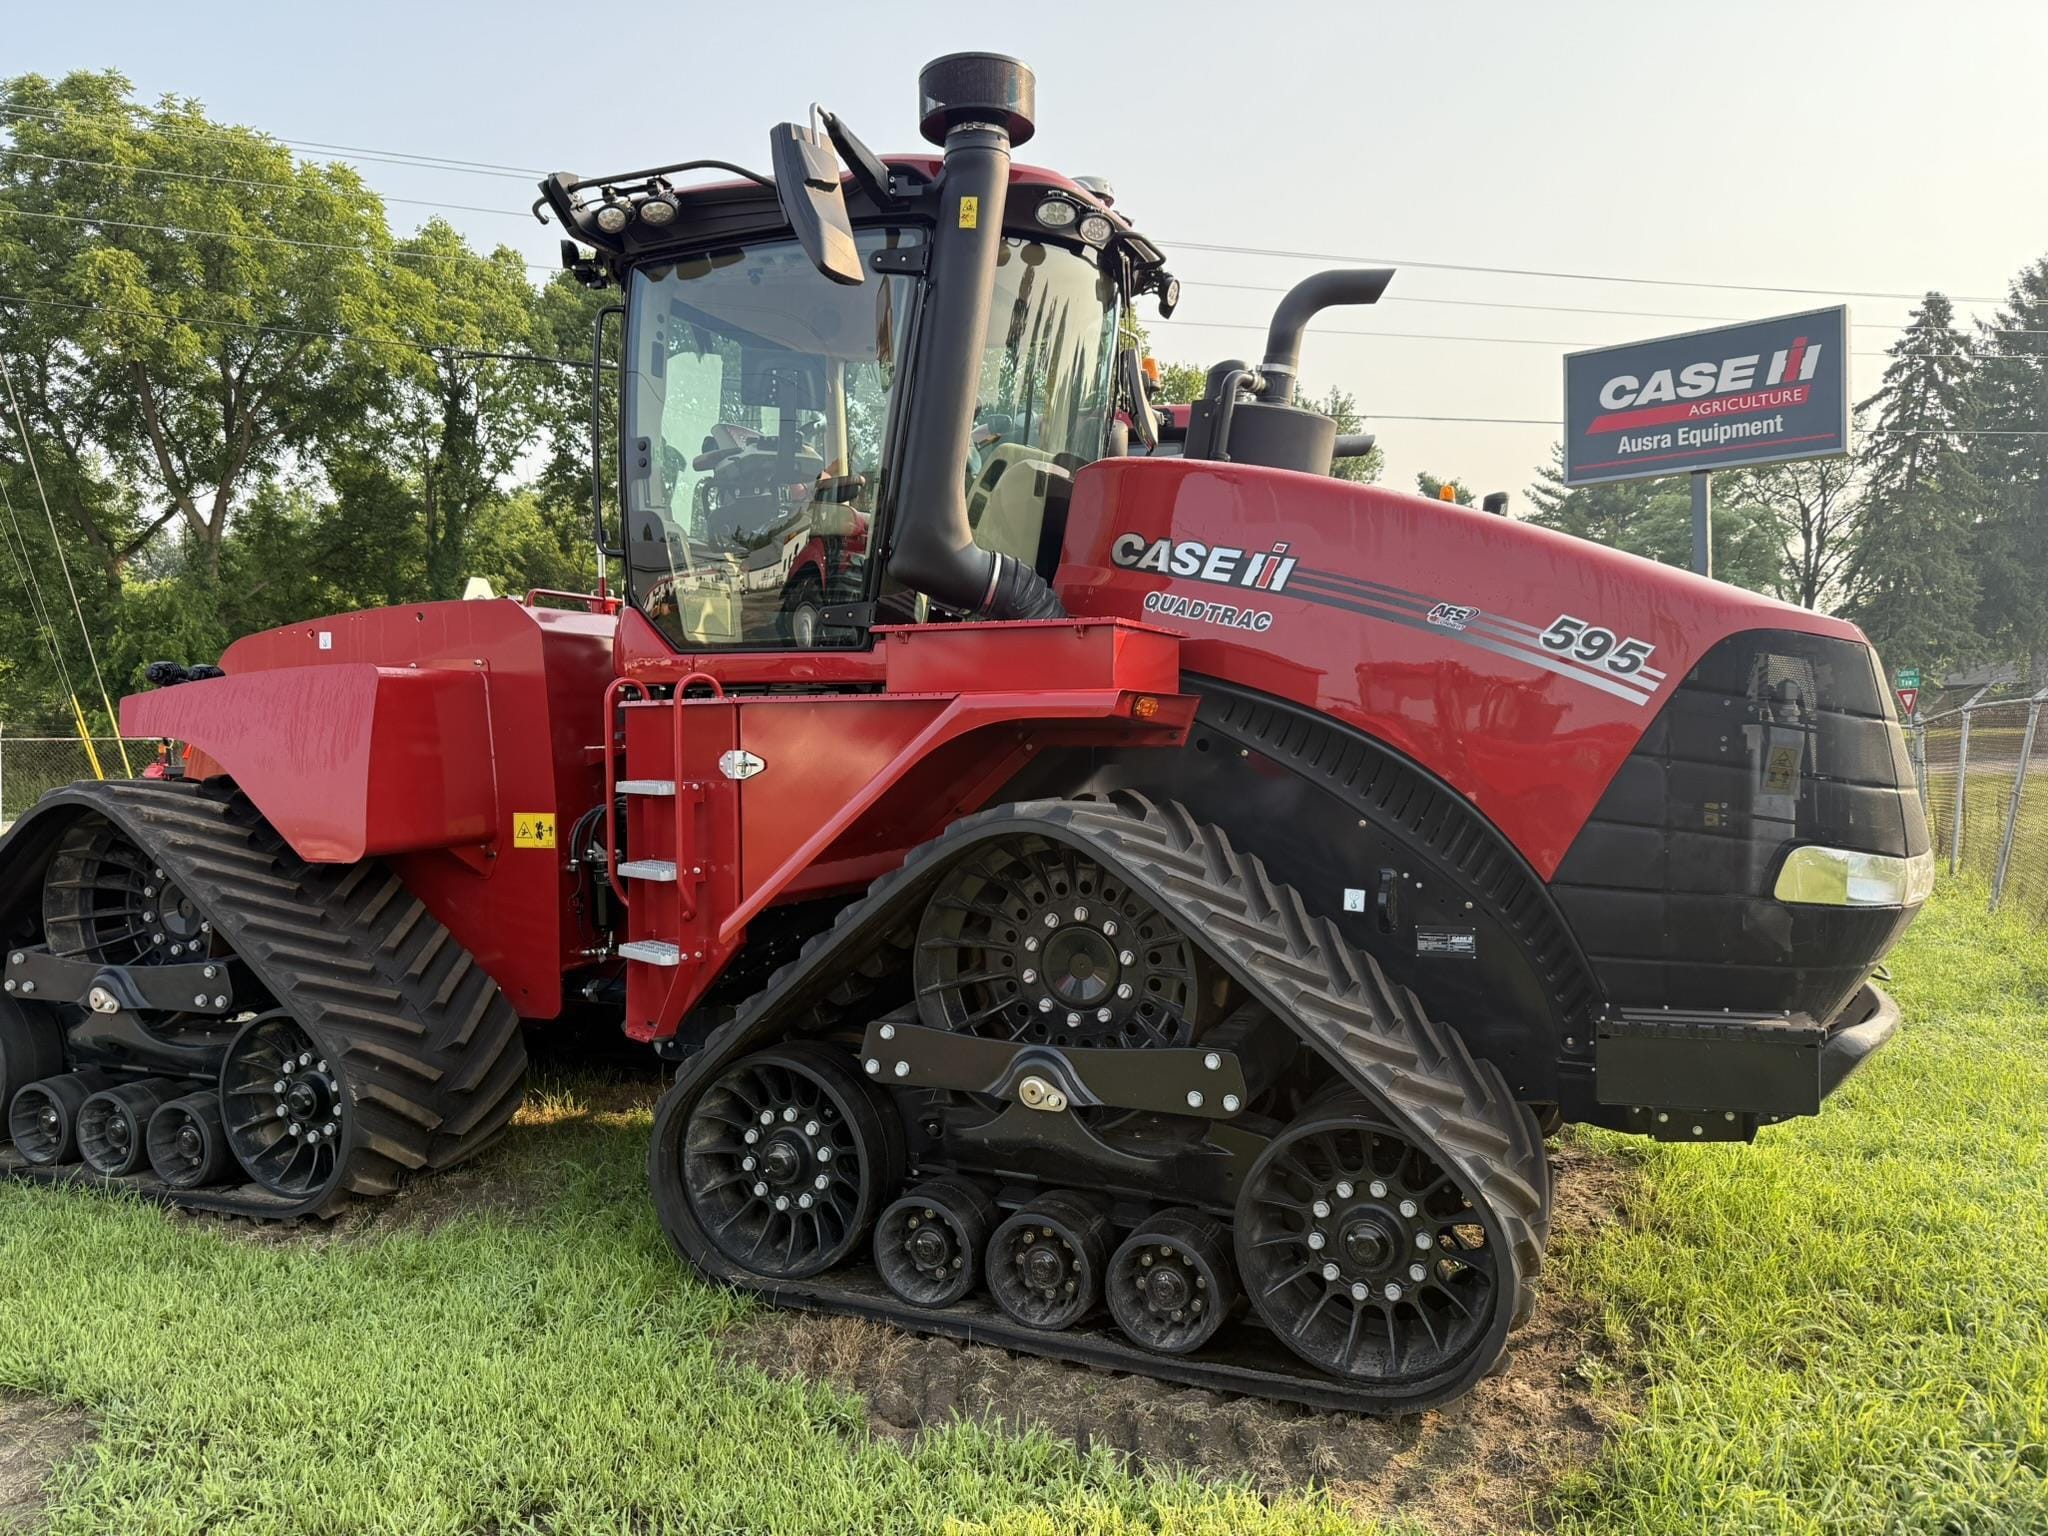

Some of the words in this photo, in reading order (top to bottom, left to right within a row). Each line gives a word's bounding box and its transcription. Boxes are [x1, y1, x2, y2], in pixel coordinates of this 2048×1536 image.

[1600, 354, 1760, 410] CASE
[1688, 388, 1803, 417] AGRICULTURE
[1617, 434, 1671, 454] Ausra
[1677, 414, 1784, 447] Equipment
[1111, 533, 1242, 583] CASE
[1144, 591, 1273, 632] QUADTRAC
[1431, 604, 1468, 621] AFS
[1539, 614, 1656, 674] 595
